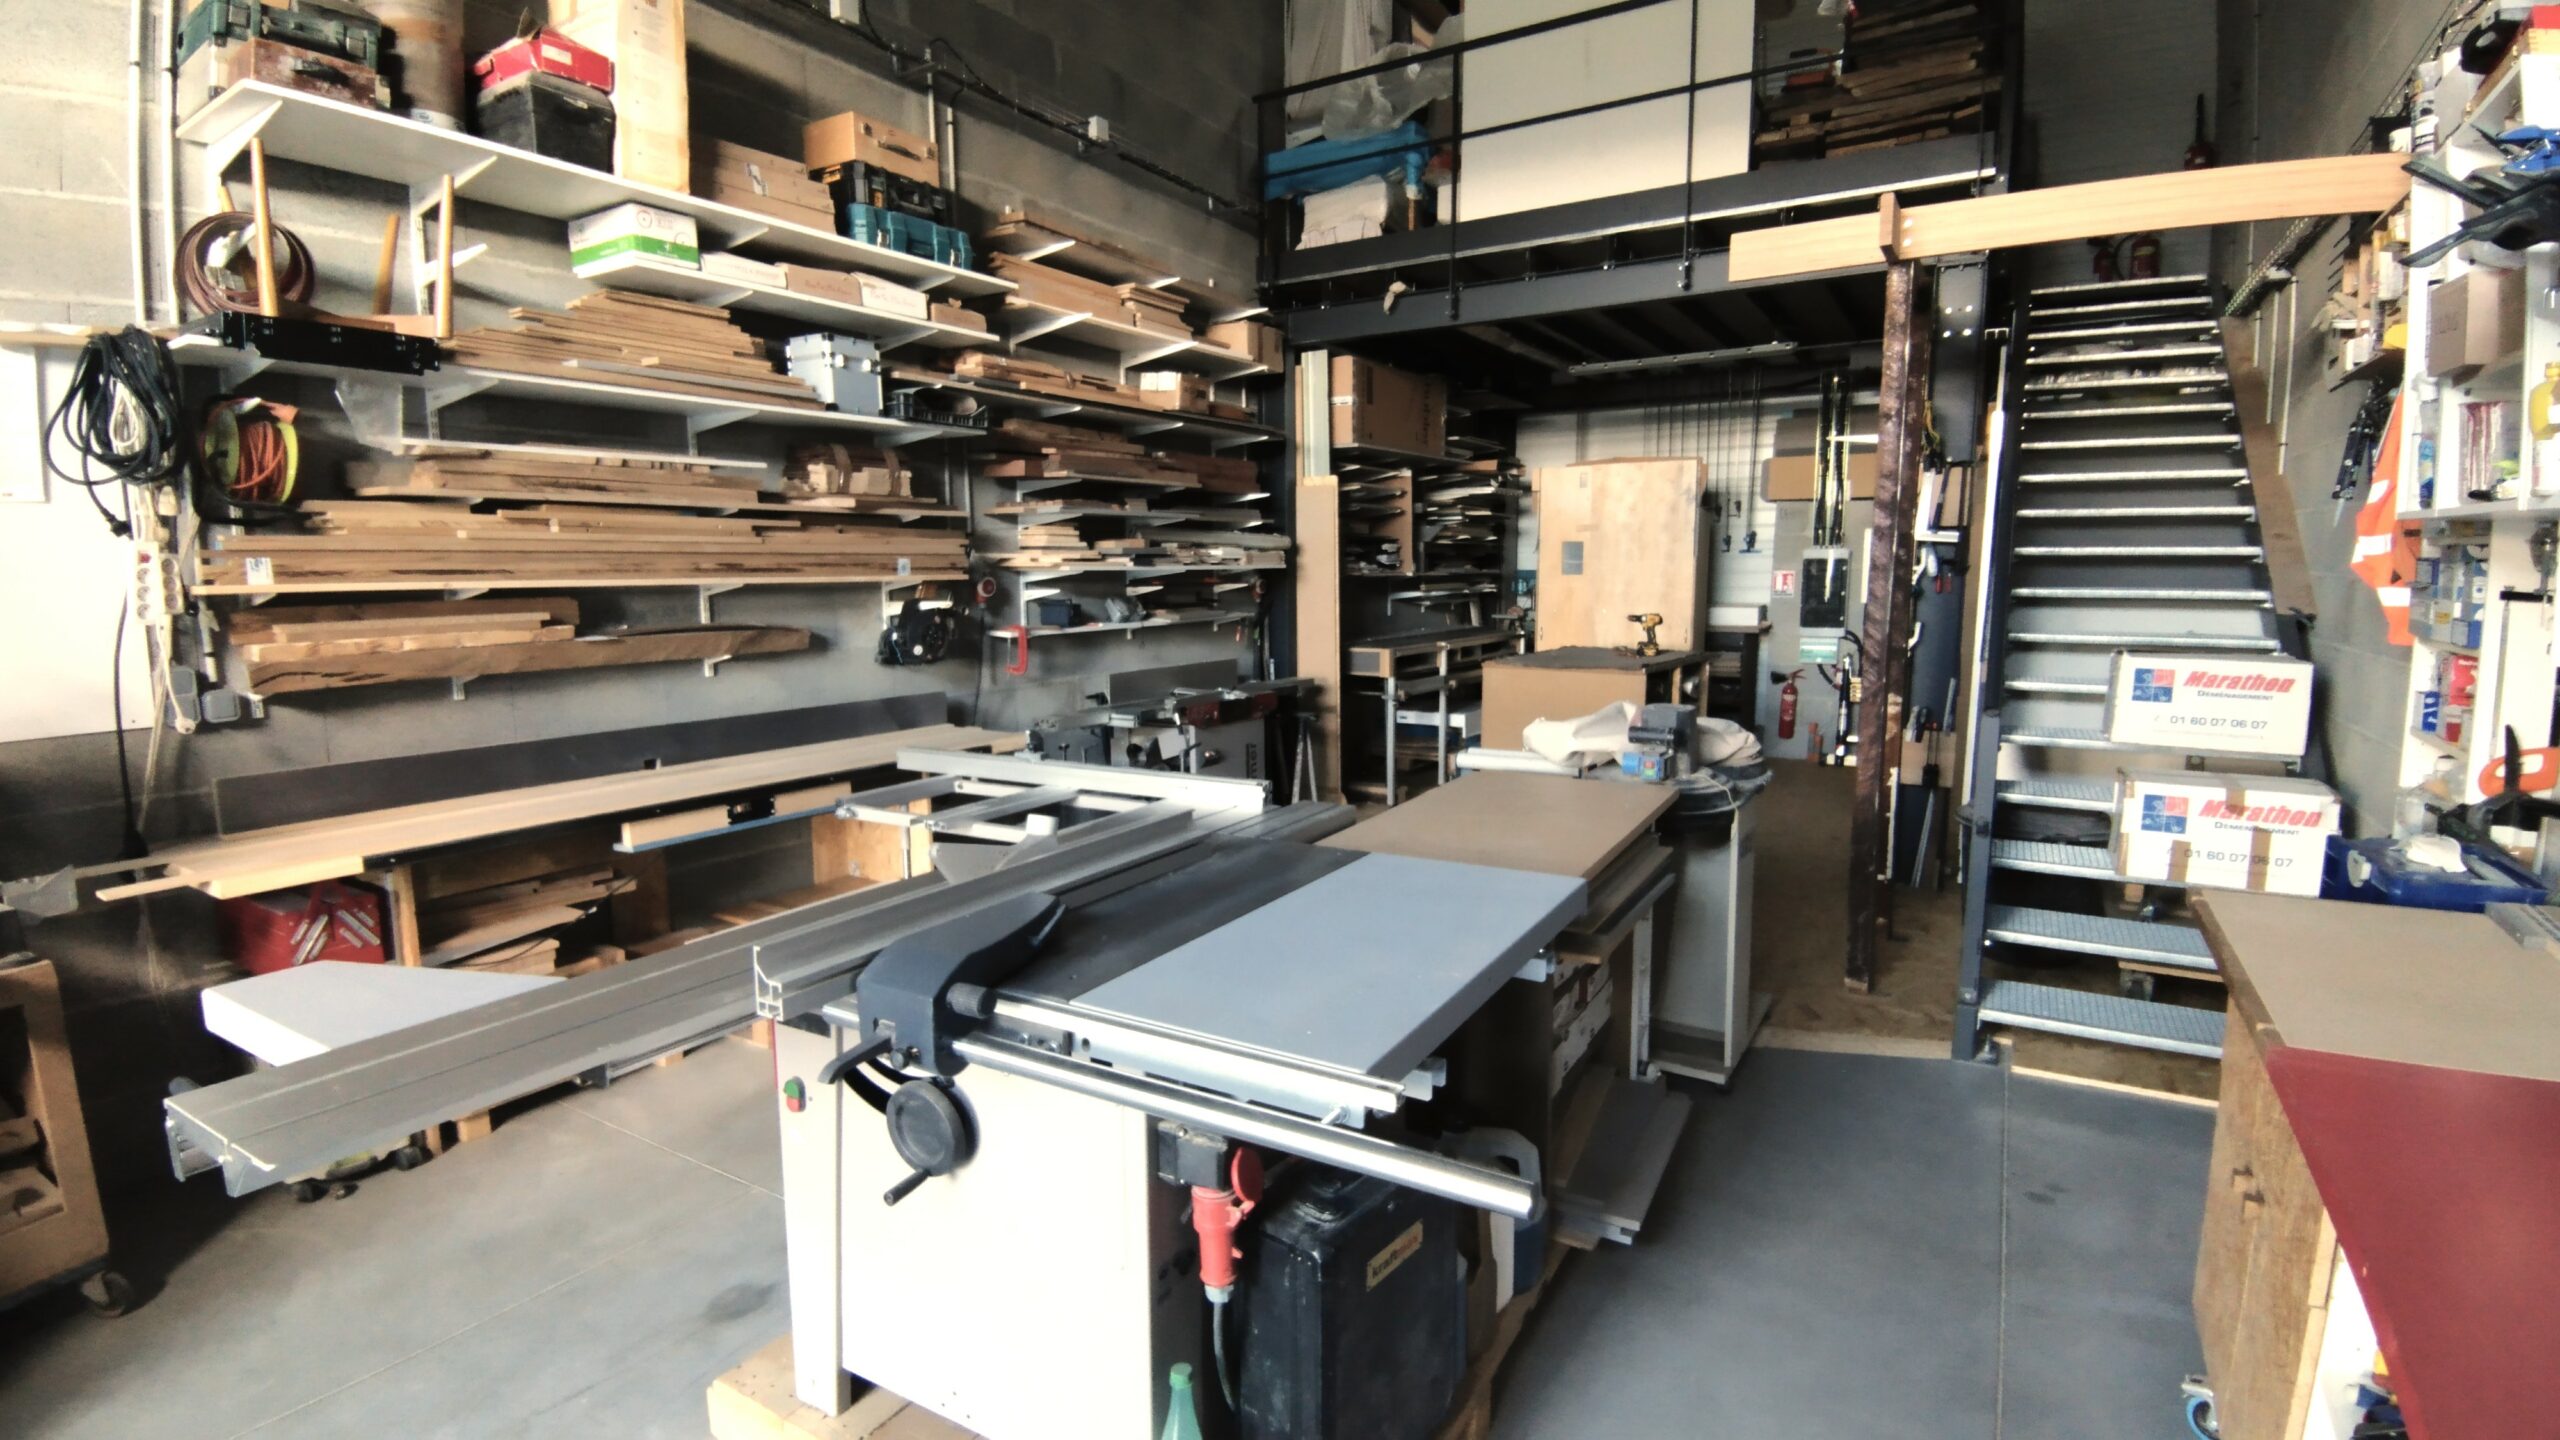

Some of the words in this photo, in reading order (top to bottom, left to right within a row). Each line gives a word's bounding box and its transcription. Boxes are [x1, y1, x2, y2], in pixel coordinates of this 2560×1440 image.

[2183, 671, 2296, 693] Marathon
[2170, 715, 2185, 724] 01
[2190, 716, 2207, 726] 60
[2210, 718, 2227, 727] 07
[2231, 719, 2247, 729] 06
[2251, 720, 2268, 730] 07
[2198, 799, 2323, 828] Marathon
[2184, 849, 2201, 859] 01
[2207, 851, 2225, 861] 60
[2229, 853, 2247, 863] 07
[2251, 855, 2270, 866] 06
[2274, 857, 2293, 868] 07
